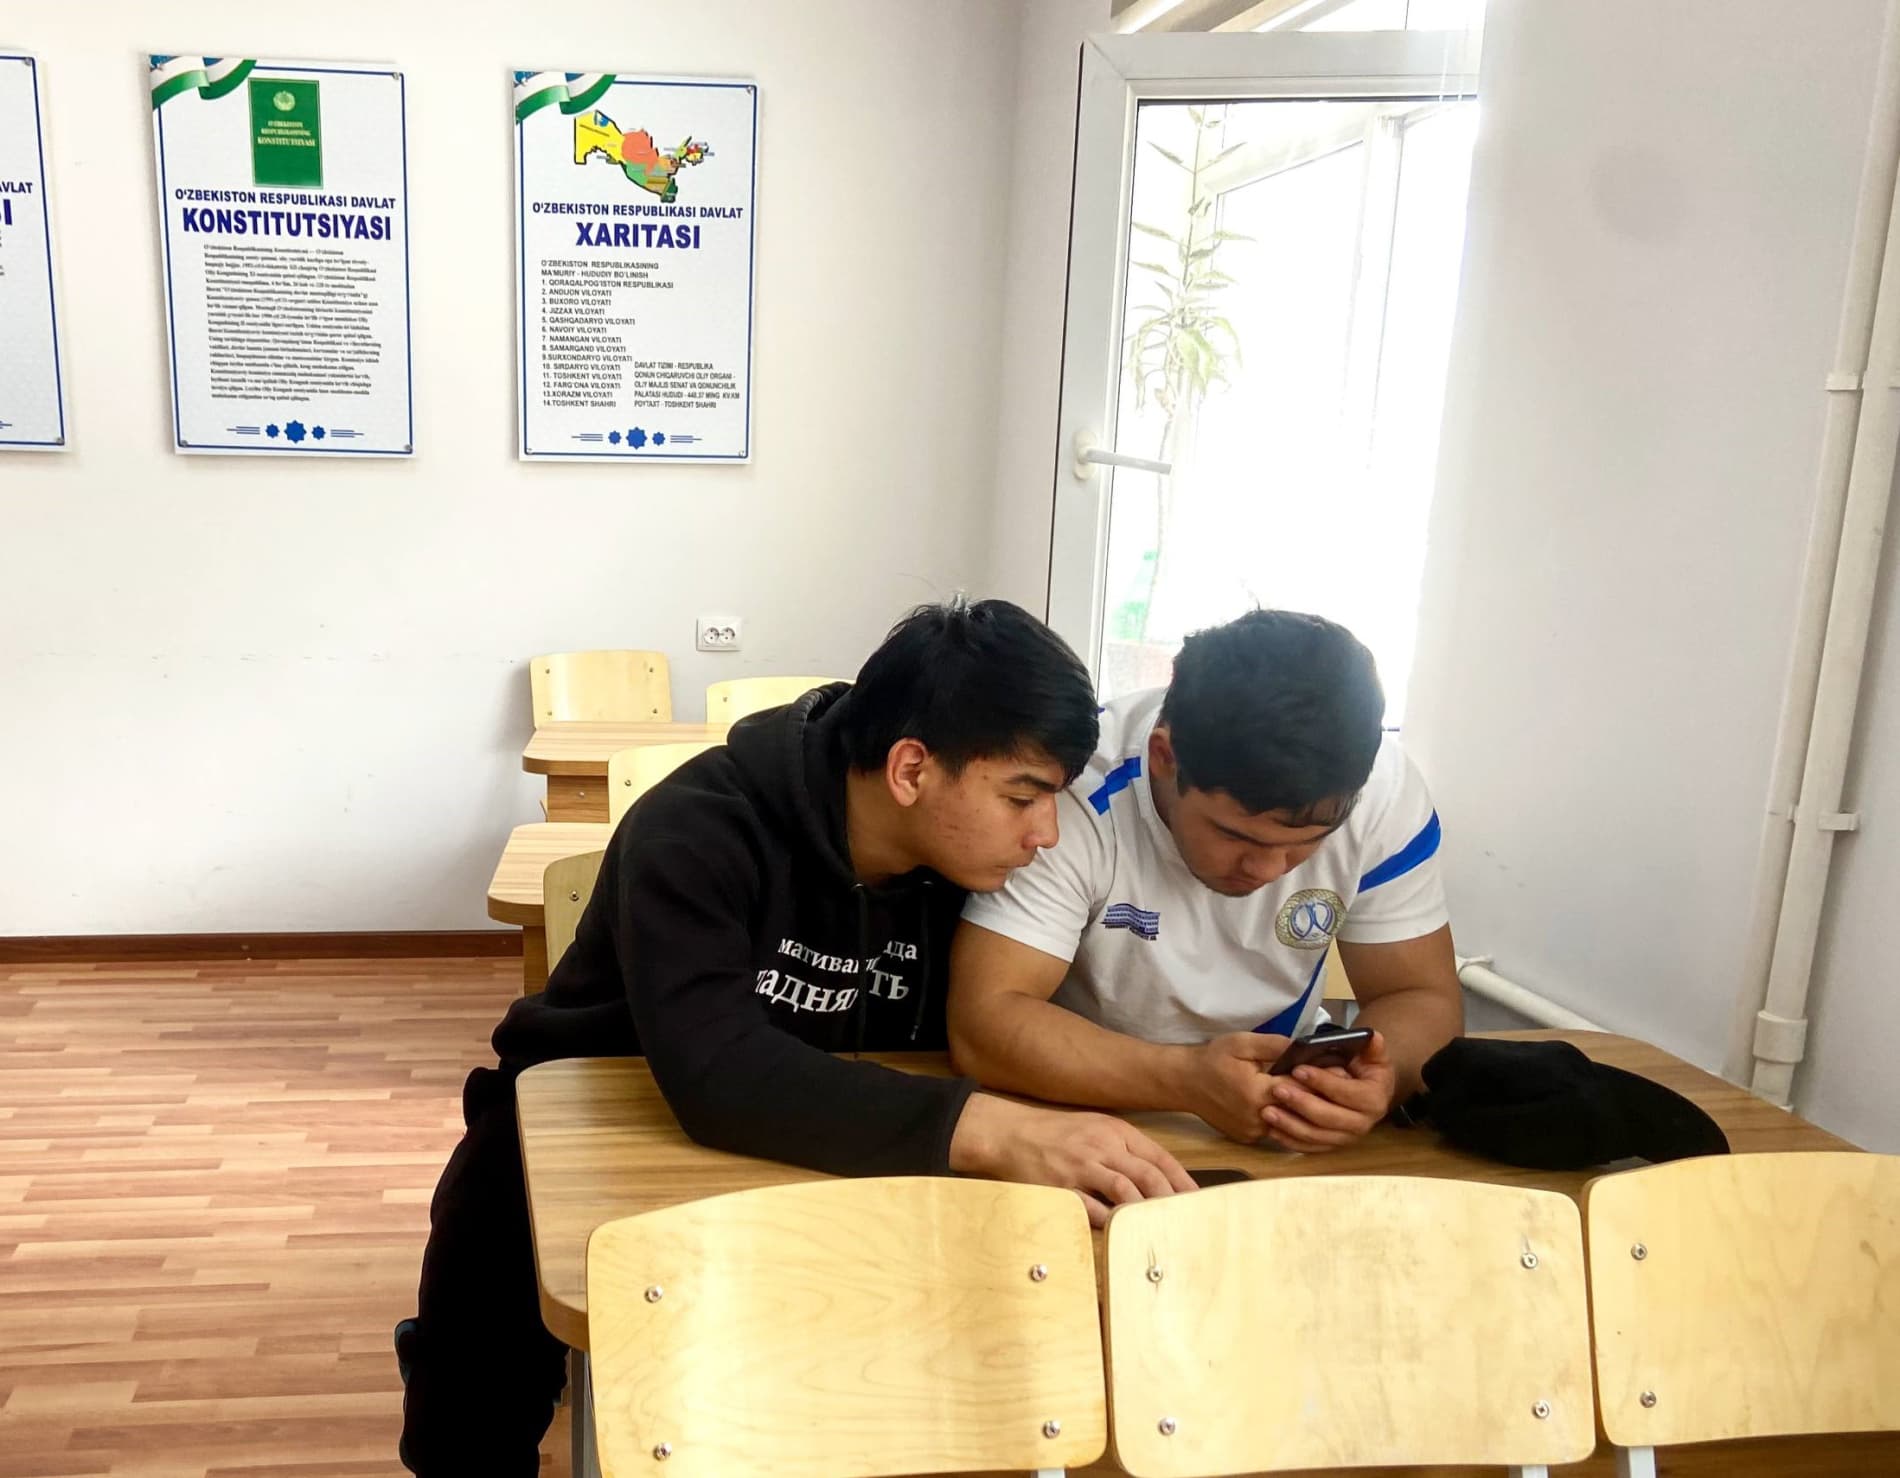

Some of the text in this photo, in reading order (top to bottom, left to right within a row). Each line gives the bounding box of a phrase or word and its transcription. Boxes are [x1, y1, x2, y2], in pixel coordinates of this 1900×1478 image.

[260, 192, 347, 207] RESPUBLIKASI
[351, 196, 396, 209] DAVLAT
[613, 204, 696, 217] RESPUBLIKASI
[700, 207, 743, 219] DAVLAT
[183, 207, 391, 240] KONSTITUTSIYASI
[575, 222, 700, 249] XARITASI
[591, 261, 659, 269] RESPUBLIKASINING
[549, 317, 603, 325] QASHQADARYO
[678, 362, 713, 370] RESPUBLIKA
